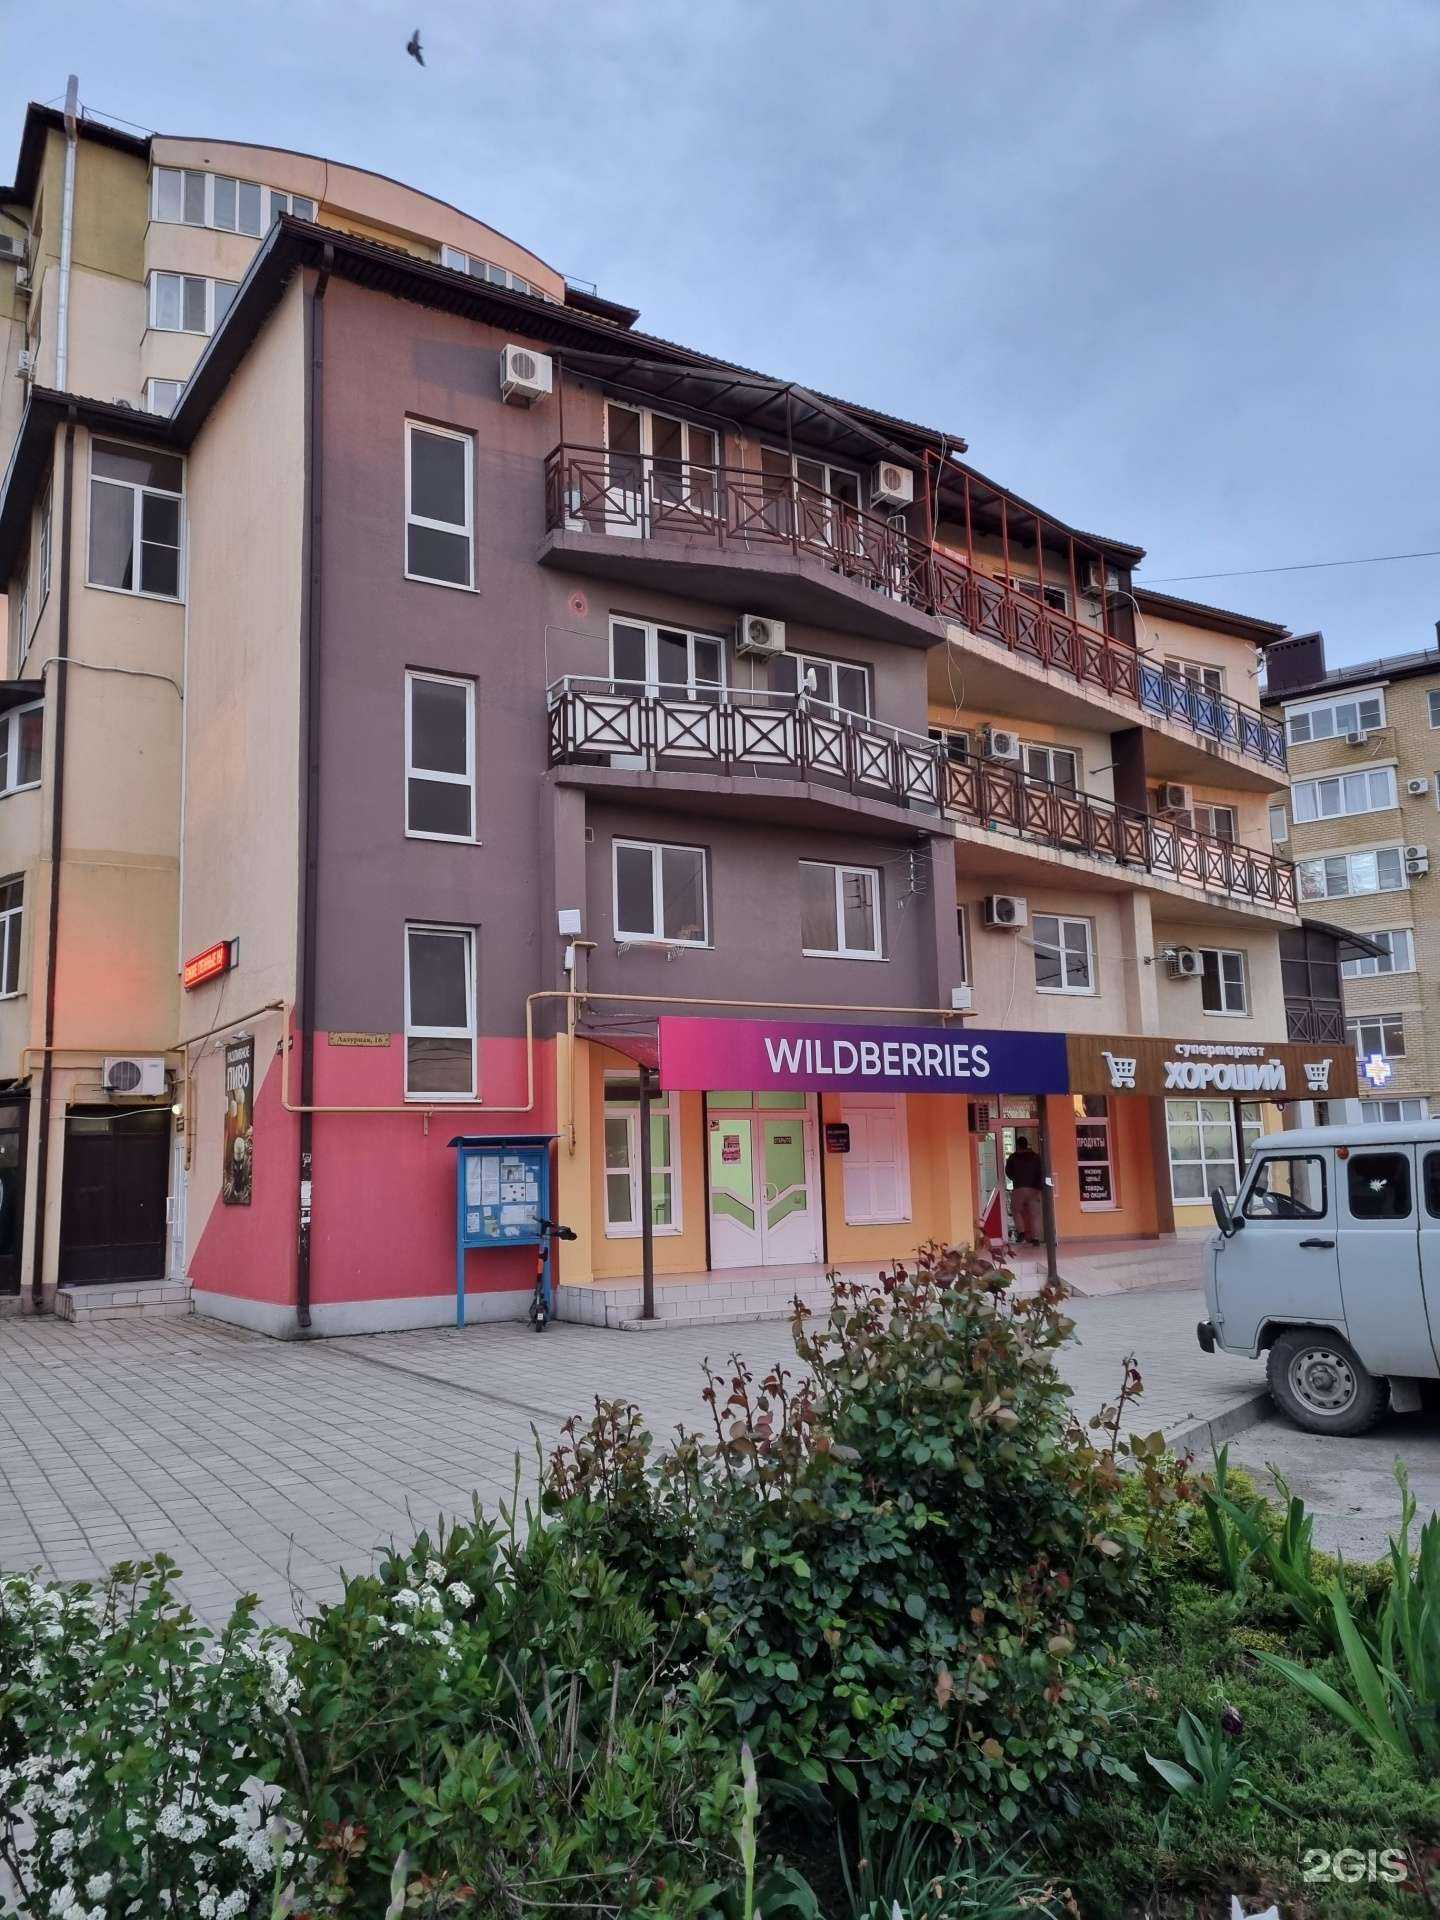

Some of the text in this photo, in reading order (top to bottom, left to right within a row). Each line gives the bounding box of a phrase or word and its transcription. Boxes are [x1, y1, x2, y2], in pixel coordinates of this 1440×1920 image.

[764, 1038, 990, 1077] WILDBERRIES
[1174, 1044, 1265, 1059] супермаркет
[227, 1062, 250, 1091] ПИВО
[1164, 1059, 1286, 1090] ХОРОШИЙ
[1076, 1137, 1105, 1148] ПРОДУКТЫ
